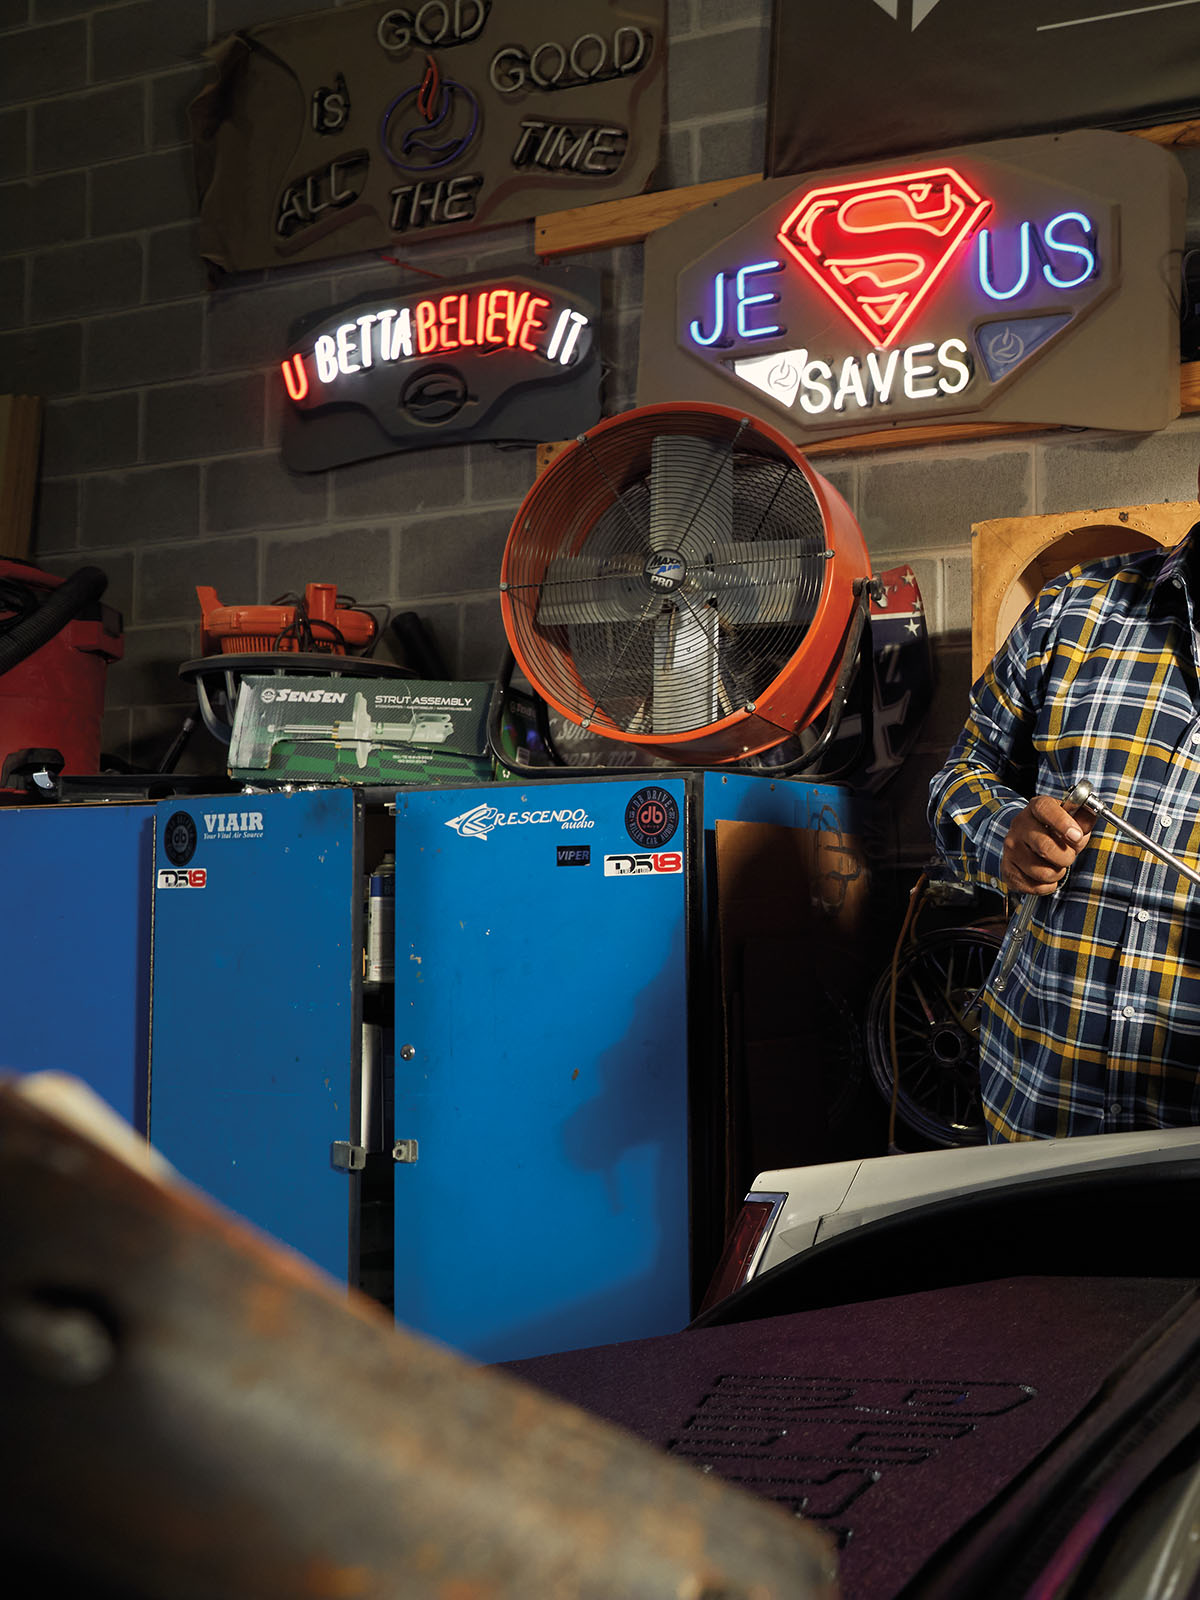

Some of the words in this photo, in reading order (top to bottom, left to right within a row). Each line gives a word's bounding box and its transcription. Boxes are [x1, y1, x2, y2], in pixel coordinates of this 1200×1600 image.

[377, 0, 486, 50] GOD
[490, 26, 646, 93] GOOD
[277, 162, 358, 236] ALL
[390, 180, 478, 230] THE
[514, 120, 625, 173] TIME
[281, 353, 309, 401] U
[314, 308, 414, 384] BETTA
[416, 289, 549, 354] BELIEVE
[547, 307, 589, 366] IT
[800, 338, 970, 415] SAVES
[650, 575, 673, 588] PRO
[375, 695, 411, 704] STRUT
[411, 697, 472, 706] ASSEMBLY
[646, 790, 672, 807] DRIVE
[203, 812, 264, 832] VIAIR
[561, 814, 595, 829] audio
[641, 806, 663, 823] db
[232, 831, 242, 839] Air
[242, 831, 264, 839] Source
[646, 837, 658, 845] CAR
[557, 850, 589, 860] VIPER
[606, 853, 682, 873] DS18
[160, 869, 206, 887] DS18
